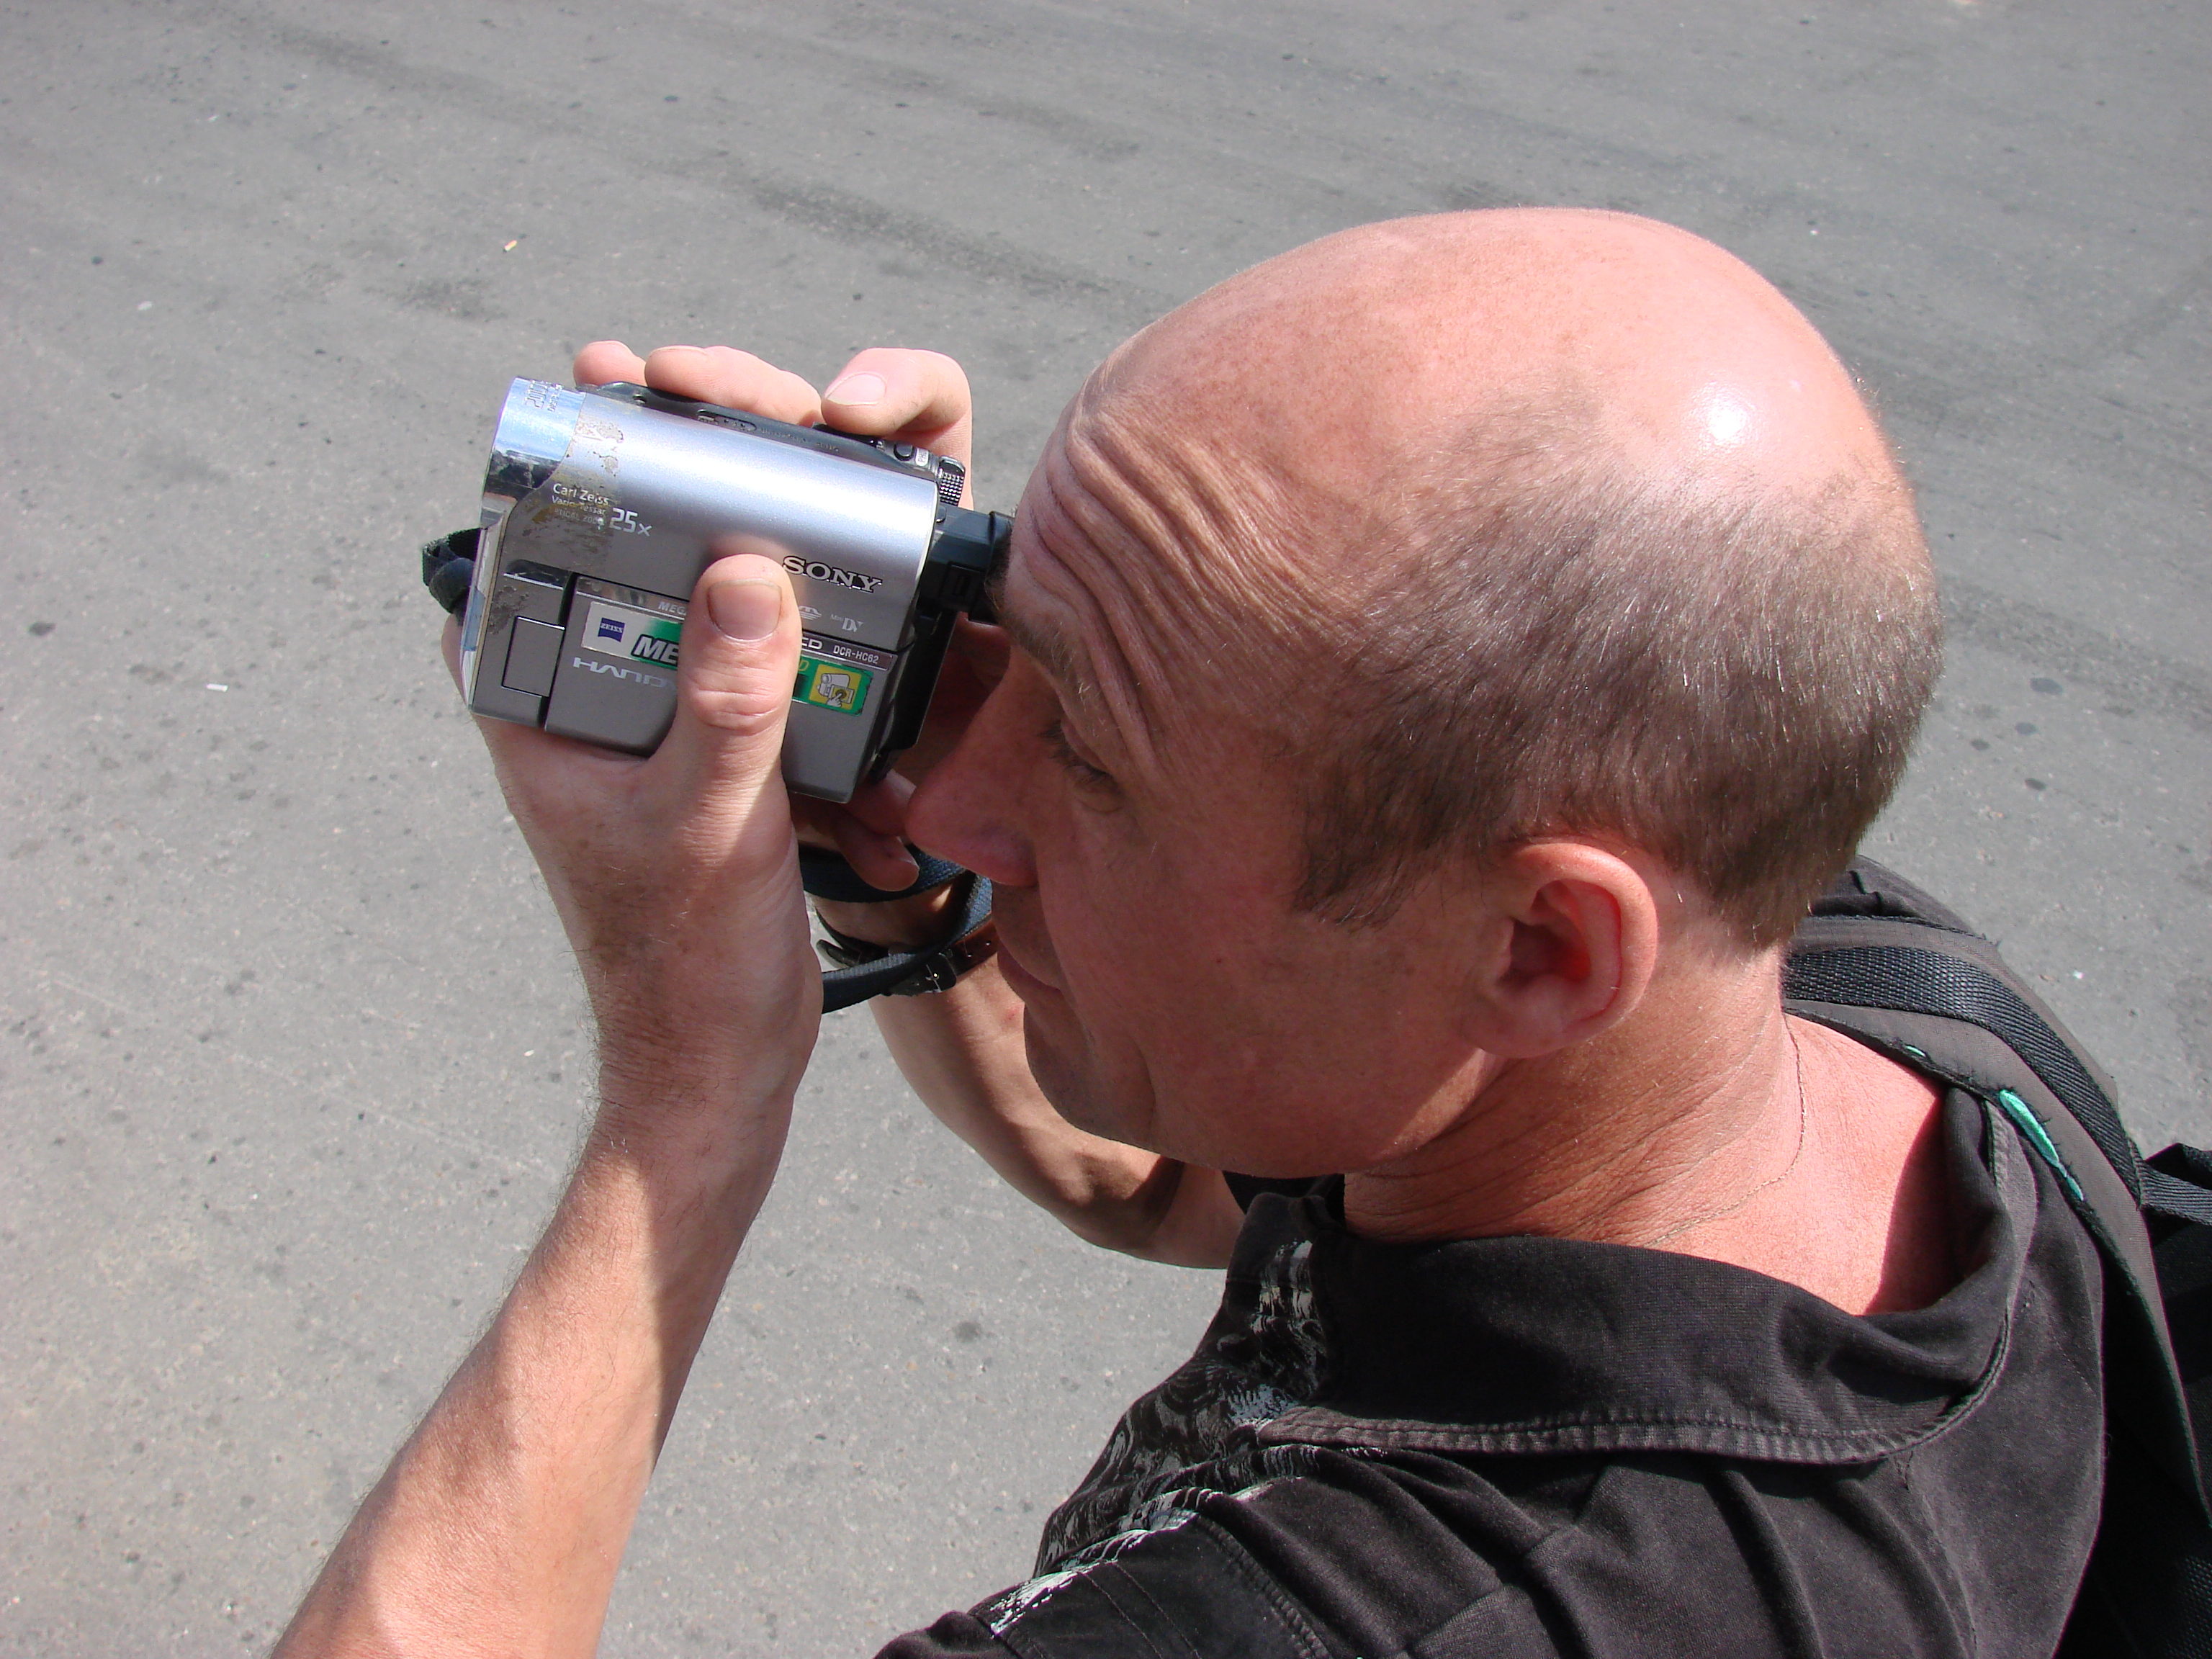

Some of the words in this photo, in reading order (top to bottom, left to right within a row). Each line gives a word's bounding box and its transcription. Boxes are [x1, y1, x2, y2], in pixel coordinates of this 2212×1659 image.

[553, 483, 577, 498] Carl
[579, 489, 610, 505] Zeiss
[552, 495, 606, 515] VarioTessar
[554, 508, 580, 521] TICAL
[583, 515, 604, 526] ZOO
[610, 507, 652, 536] 25x
[782, 555, 883, 593] SONY
[658, 601, 686, 616] MEG
[600, 622, 624, 634] ZEISS
[632, 635, 679, 666] ME
[833, 645, 879, 664] DCR-HC62
